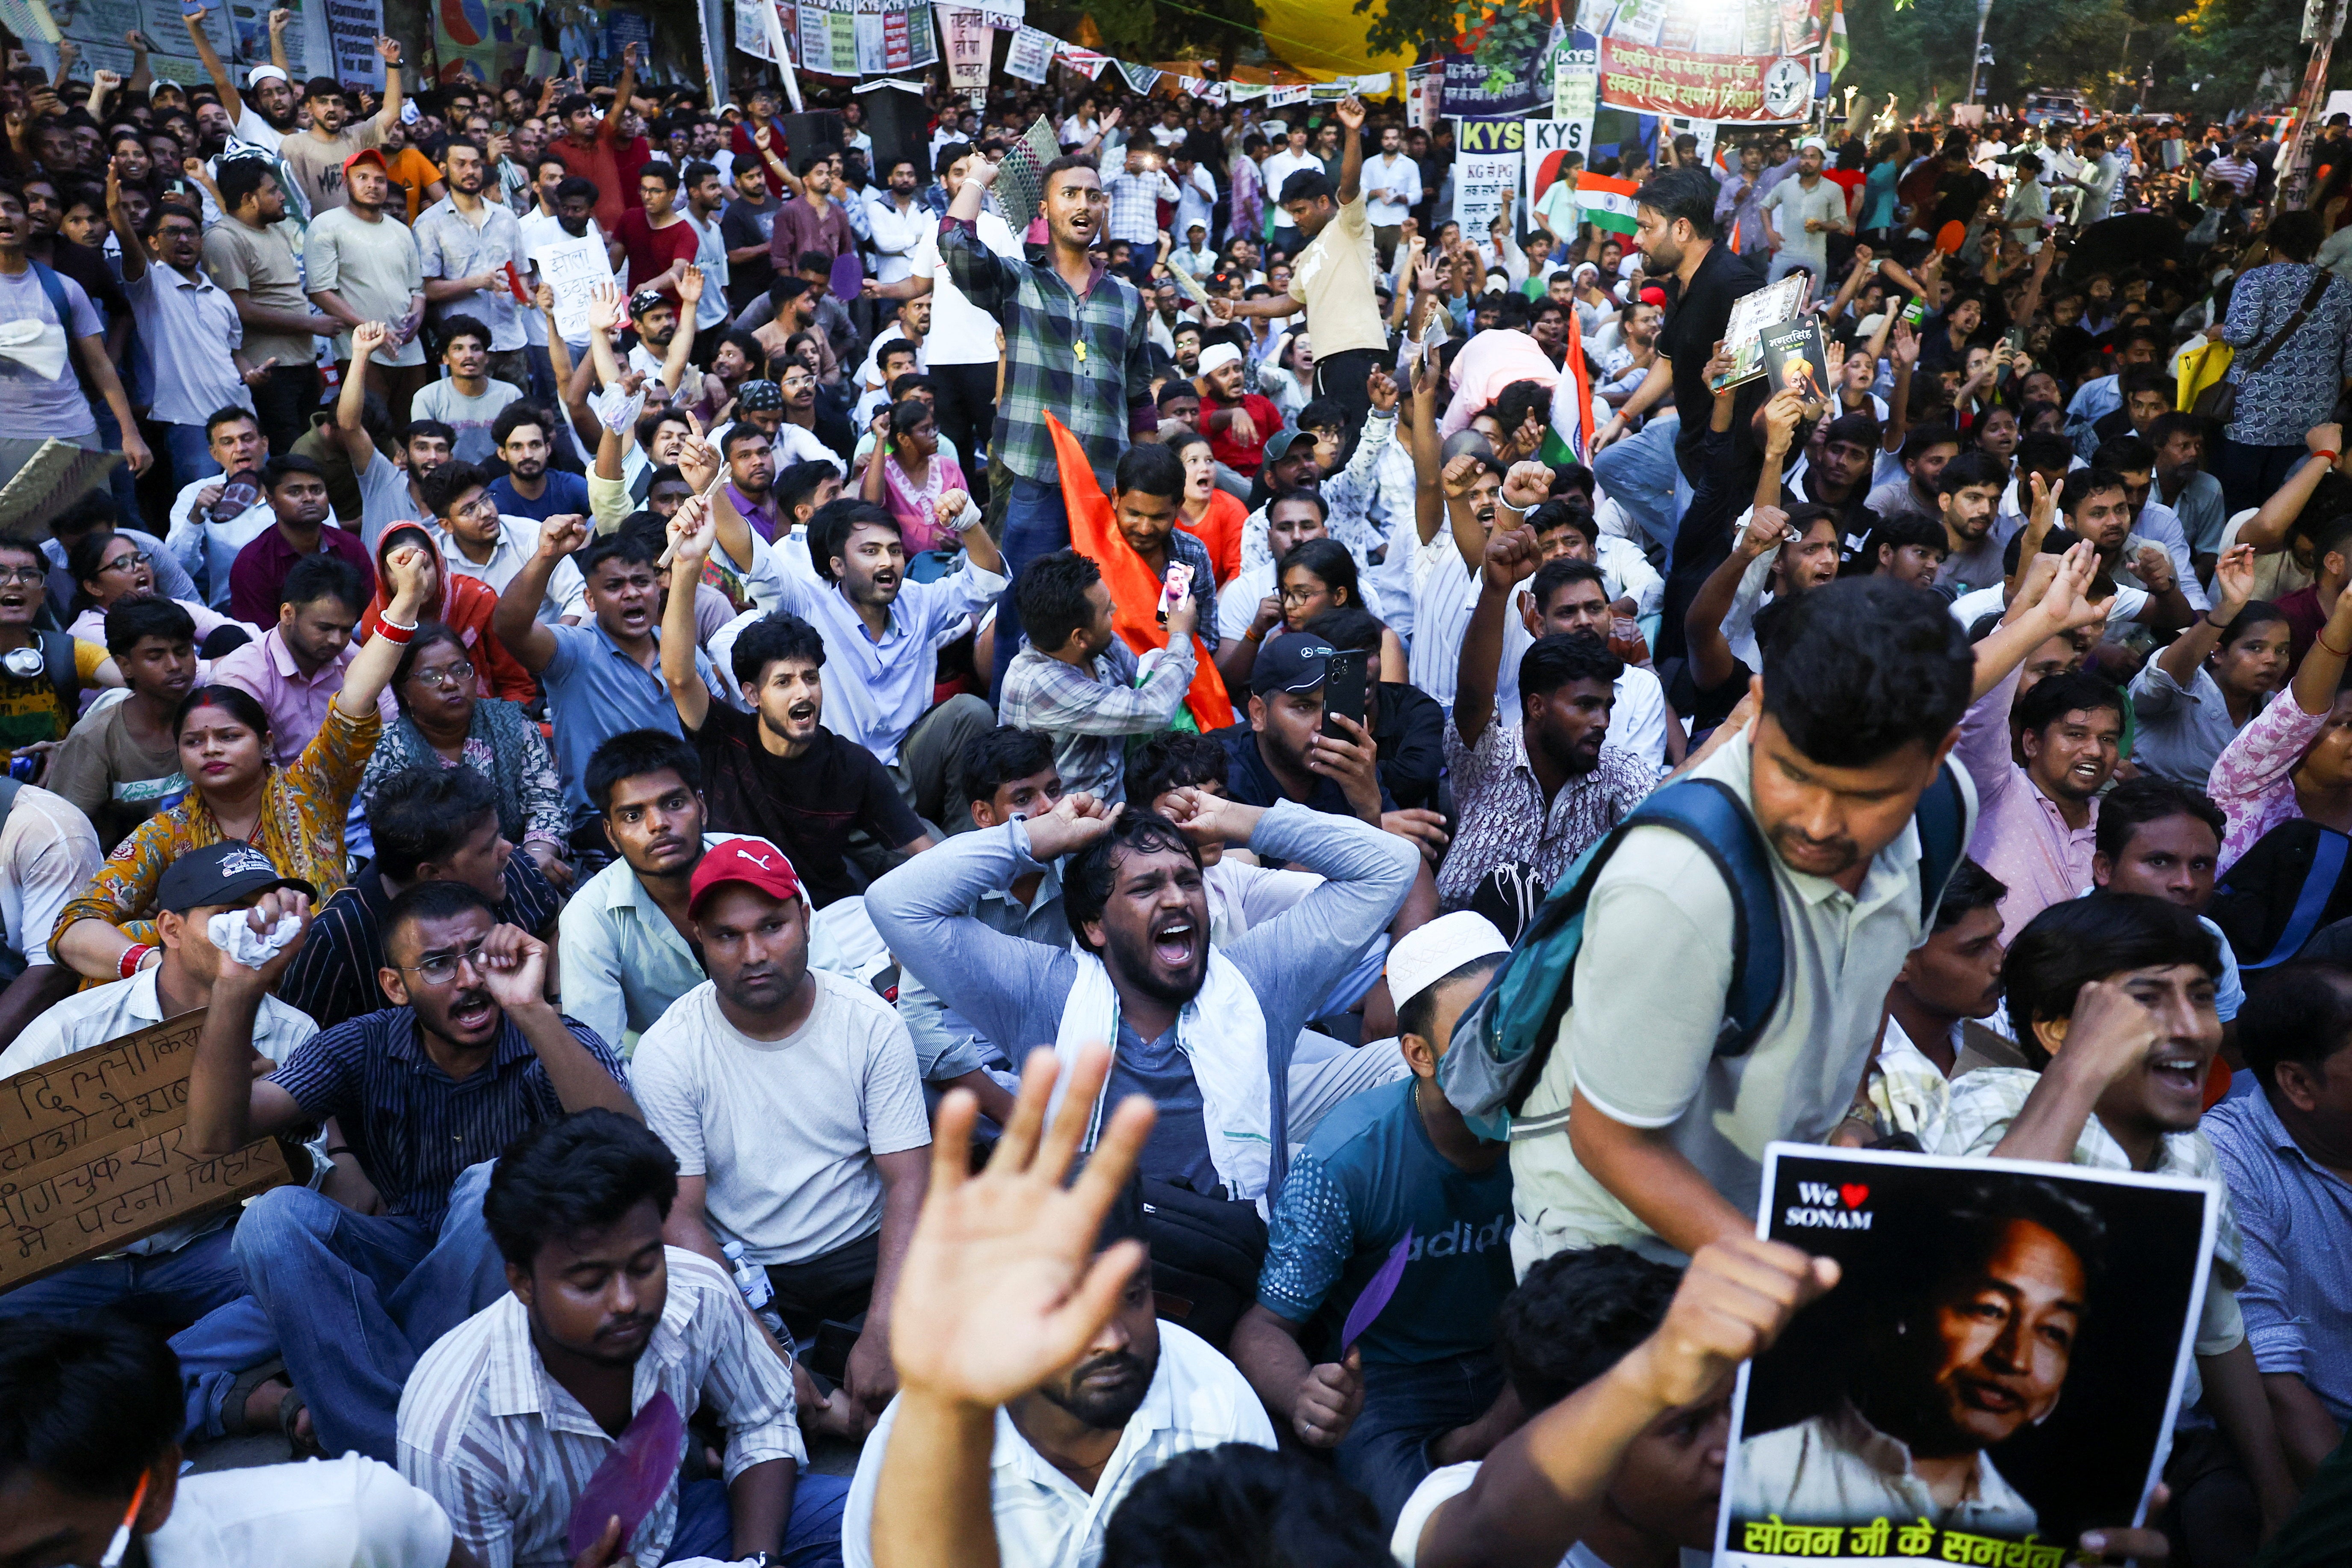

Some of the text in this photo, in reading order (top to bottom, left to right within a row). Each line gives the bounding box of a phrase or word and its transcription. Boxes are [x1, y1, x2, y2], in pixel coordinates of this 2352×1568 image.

[987, 12, 1019, 29] KYS
[1559, 49, 1595, 62] KYS
[1463, 121, 1524, 150] KYS
[1537, 123, 1582, 149] KYS
[1468, 165, 1483, 178] KG
[1498, 164, 1513, 178] PG
[1768, 329, 1812, 348] भगतसिंह
[74, 1174, 172, 1234] पटना
[1799, 1181, 1839, 1207] We
[1784, 1205, 1874, 1230] SONAM
[1389, 1214, 1515, 1262] adid
[1744, 1514, 1845, 1557] सोनम
[1850, 1516, 1893, 1557] जी
[1897, 1516, 1937, 1557] के
[1941, 1531, 2067, 1568] समर्थन
